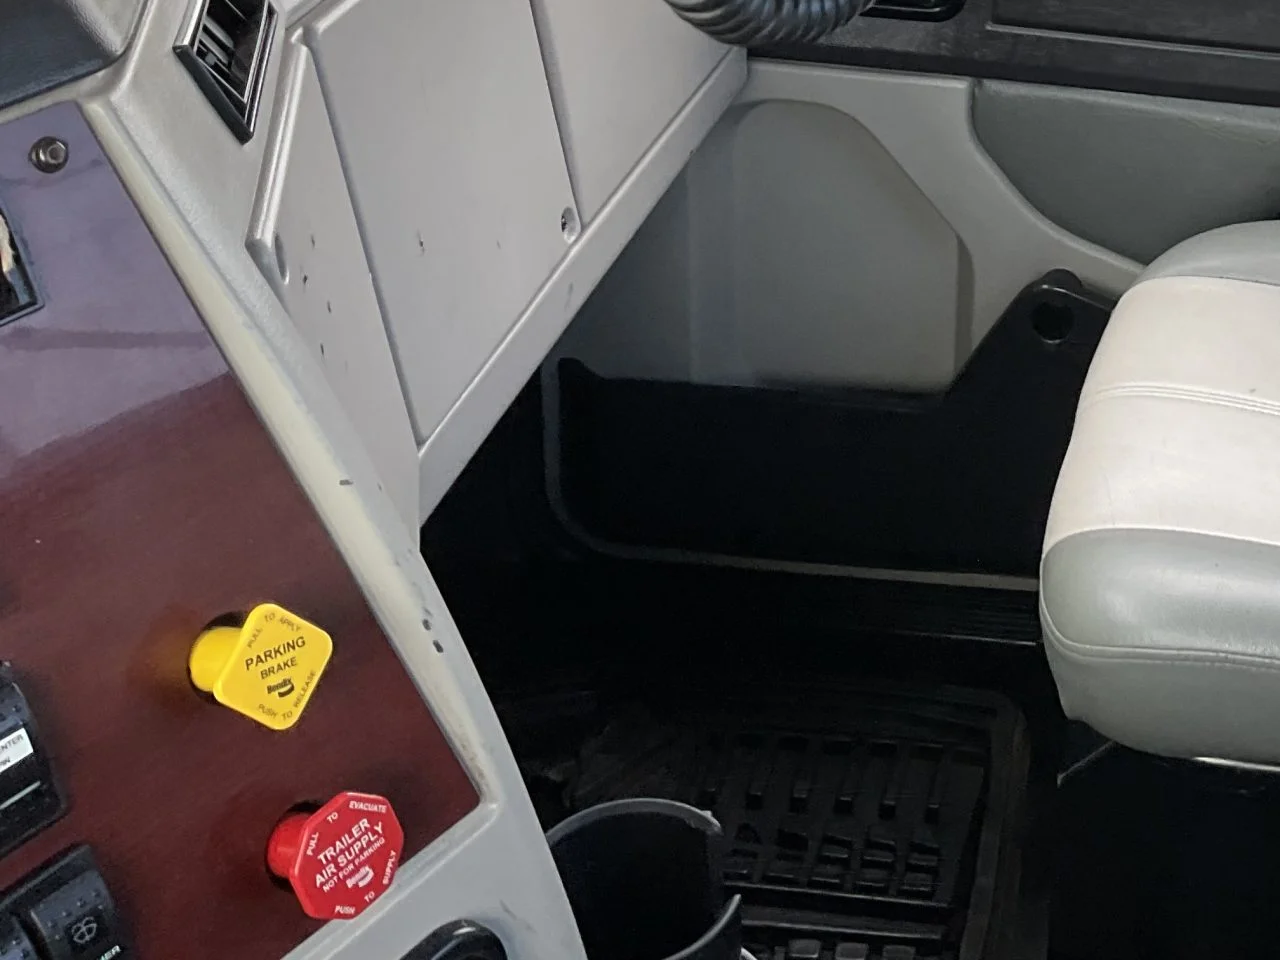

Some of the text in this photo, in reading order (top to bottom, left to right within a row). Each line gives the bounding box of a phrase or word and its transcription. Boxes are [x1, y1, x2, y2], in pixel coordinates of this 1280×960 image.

[245, 636, 306, 671] PARKING
[247, 612, 302, 649] PULL TO APPLY
[260, 656, 298, 680] BRAKE
[267, 677, 293, 695] Bendix
[258, 669, 316, 721] PUSH TO RELEASE
[306, 800, 388, 856] PULL TO EVACUATE
[317, 818, 370, 865] TRAILER
[315, 821, 383, 888] AIR SUPPLY
[322, 837, 385, 893] NOT FOR PARKING
[334, 850, 396, 914] PUSH TO SUPPLY
